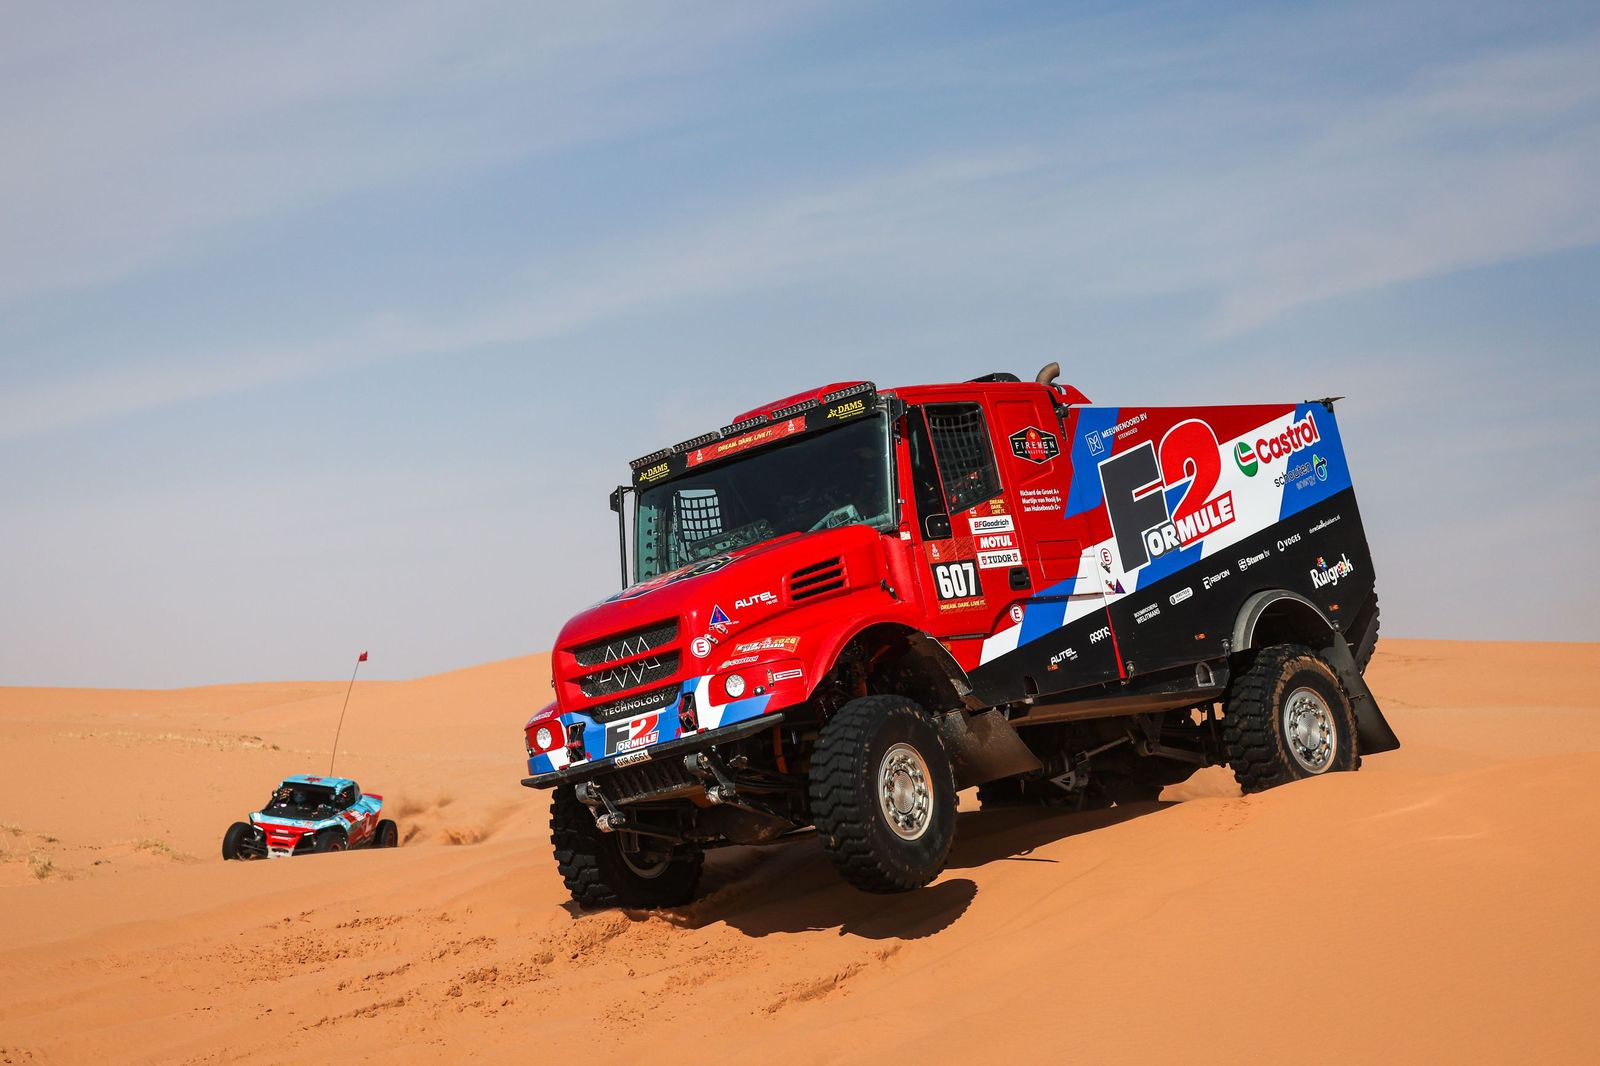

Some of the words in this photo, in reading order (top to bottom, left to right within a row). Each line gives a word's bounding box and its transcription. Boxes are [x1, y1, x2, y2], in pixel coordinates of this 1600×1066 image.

[838, 399, 863, 414] DAMS
[1015, 441, 1055, 450] FIREMEN
[1255, 414, 1319, 464] Castrol
[647, 462, 668, 477] DAMS
[974, 519, 1009, 528] BFGoodrich
[980, 535, 1012, 549] MOTUL
[988, 554, 1012, 564] TUDOR
[1310, 553, 1354, 589] Ruigrok
[936, 563, 976, 599] 607
[735, 591, 777, 610] AUTEL
[696, 641, 706, 653] E
[1050, 647, 1077, 666] AUTEL
[602, 693, 665, 716] TECHNOLOGY
